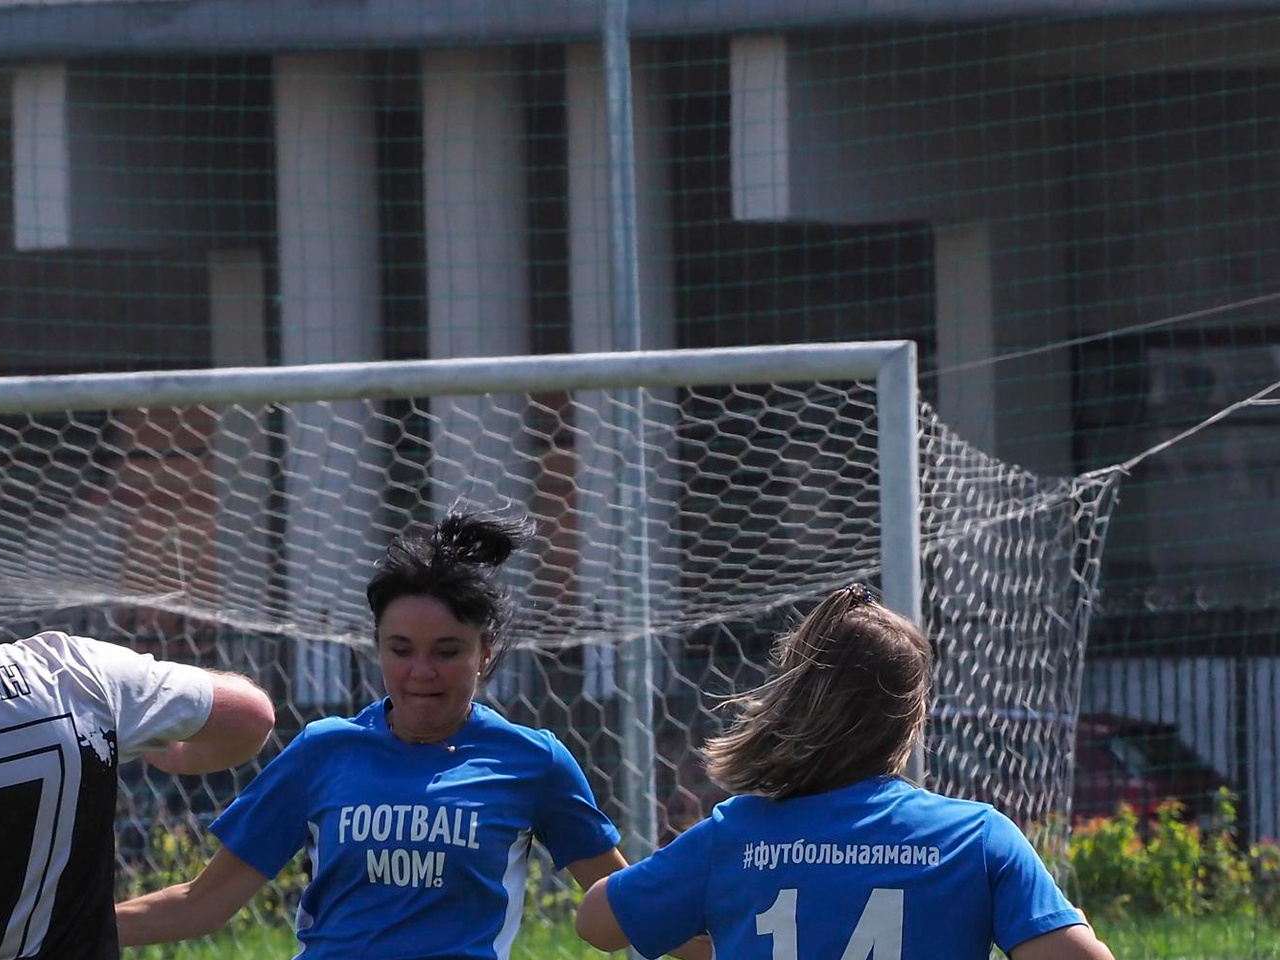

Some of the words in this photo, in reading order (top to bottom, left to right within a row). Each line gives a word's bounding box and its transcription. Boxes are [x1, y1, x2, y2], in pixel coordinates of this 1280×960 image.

[339, 804, 480, 849] FOOTBALL
[367, 849, 445, 888] MOM!
[743, 838, 940, 870] #футбольнаямама
